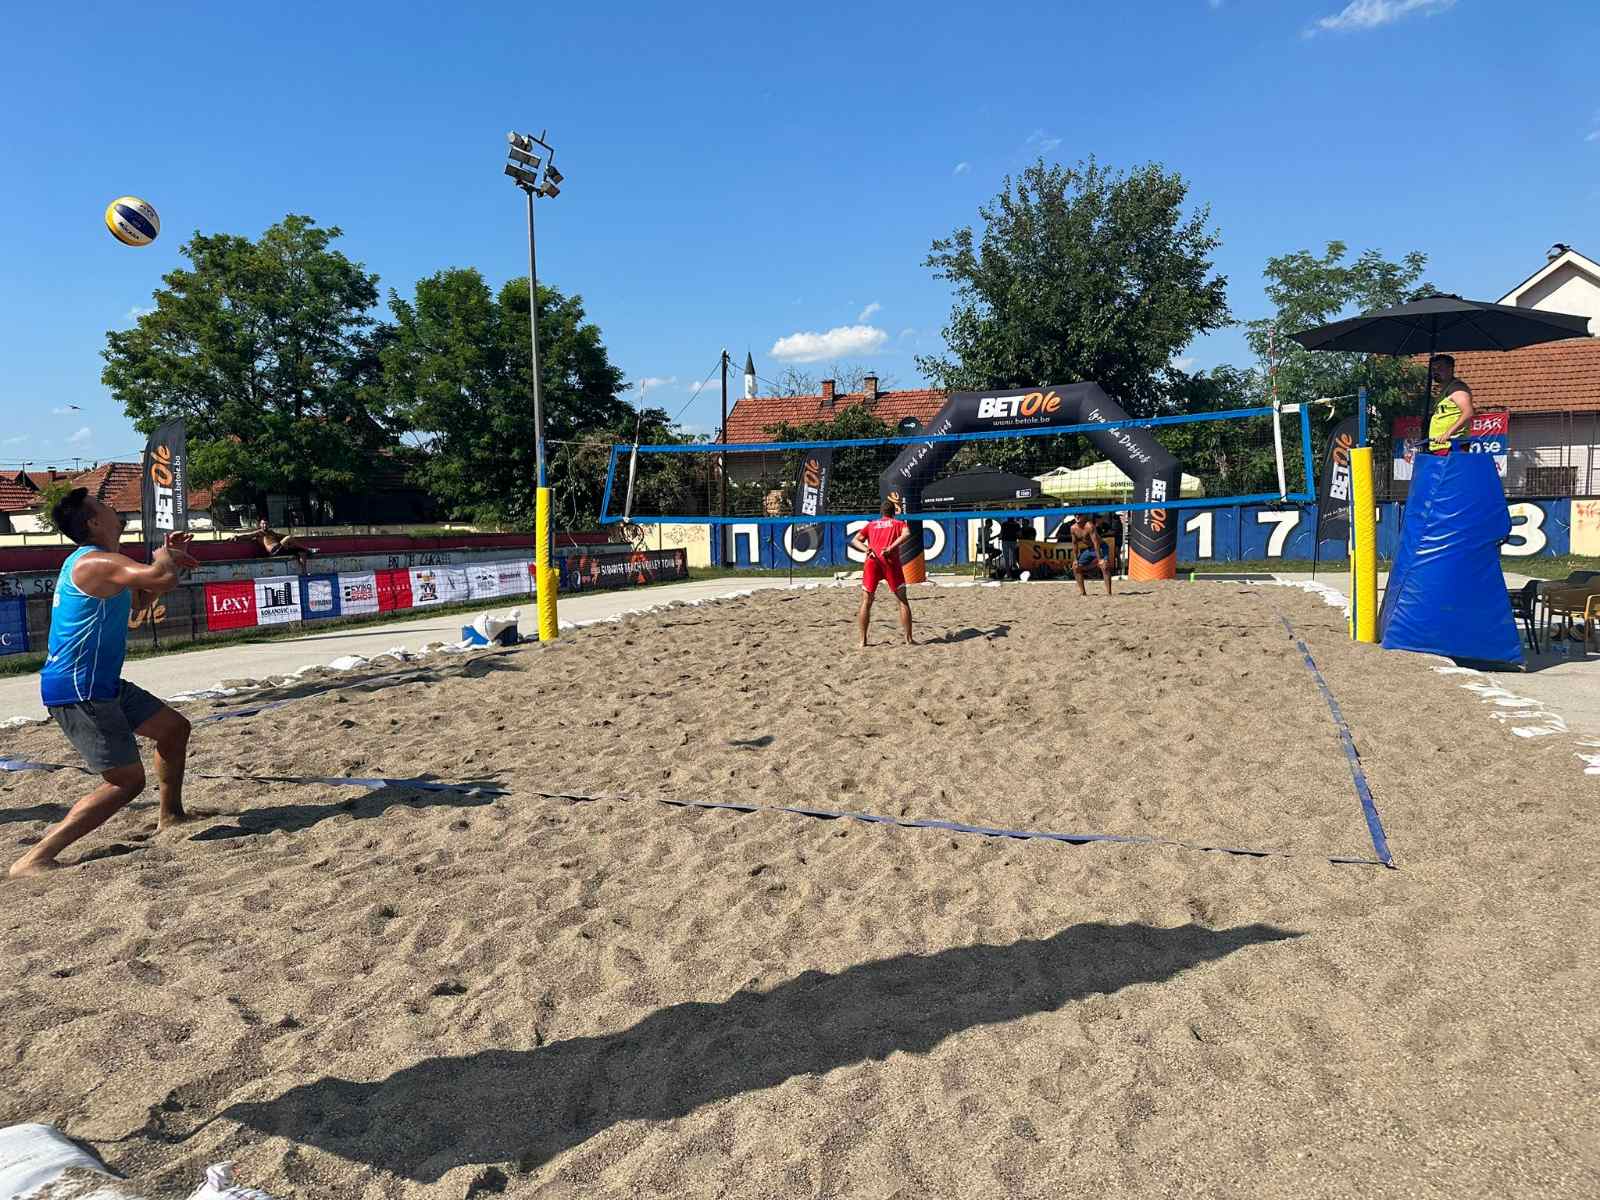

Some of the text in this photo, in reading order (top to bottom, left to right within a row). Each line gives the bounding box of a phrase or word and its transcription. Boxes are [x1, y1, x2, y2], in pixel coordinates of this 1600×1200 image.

[977, 391, 1062, 419] BETOle
[151, 445, 175, 530] BETOle
[1150, 478, 1168, 533] BEOle
[211, 594, 251, 613] Lexy
